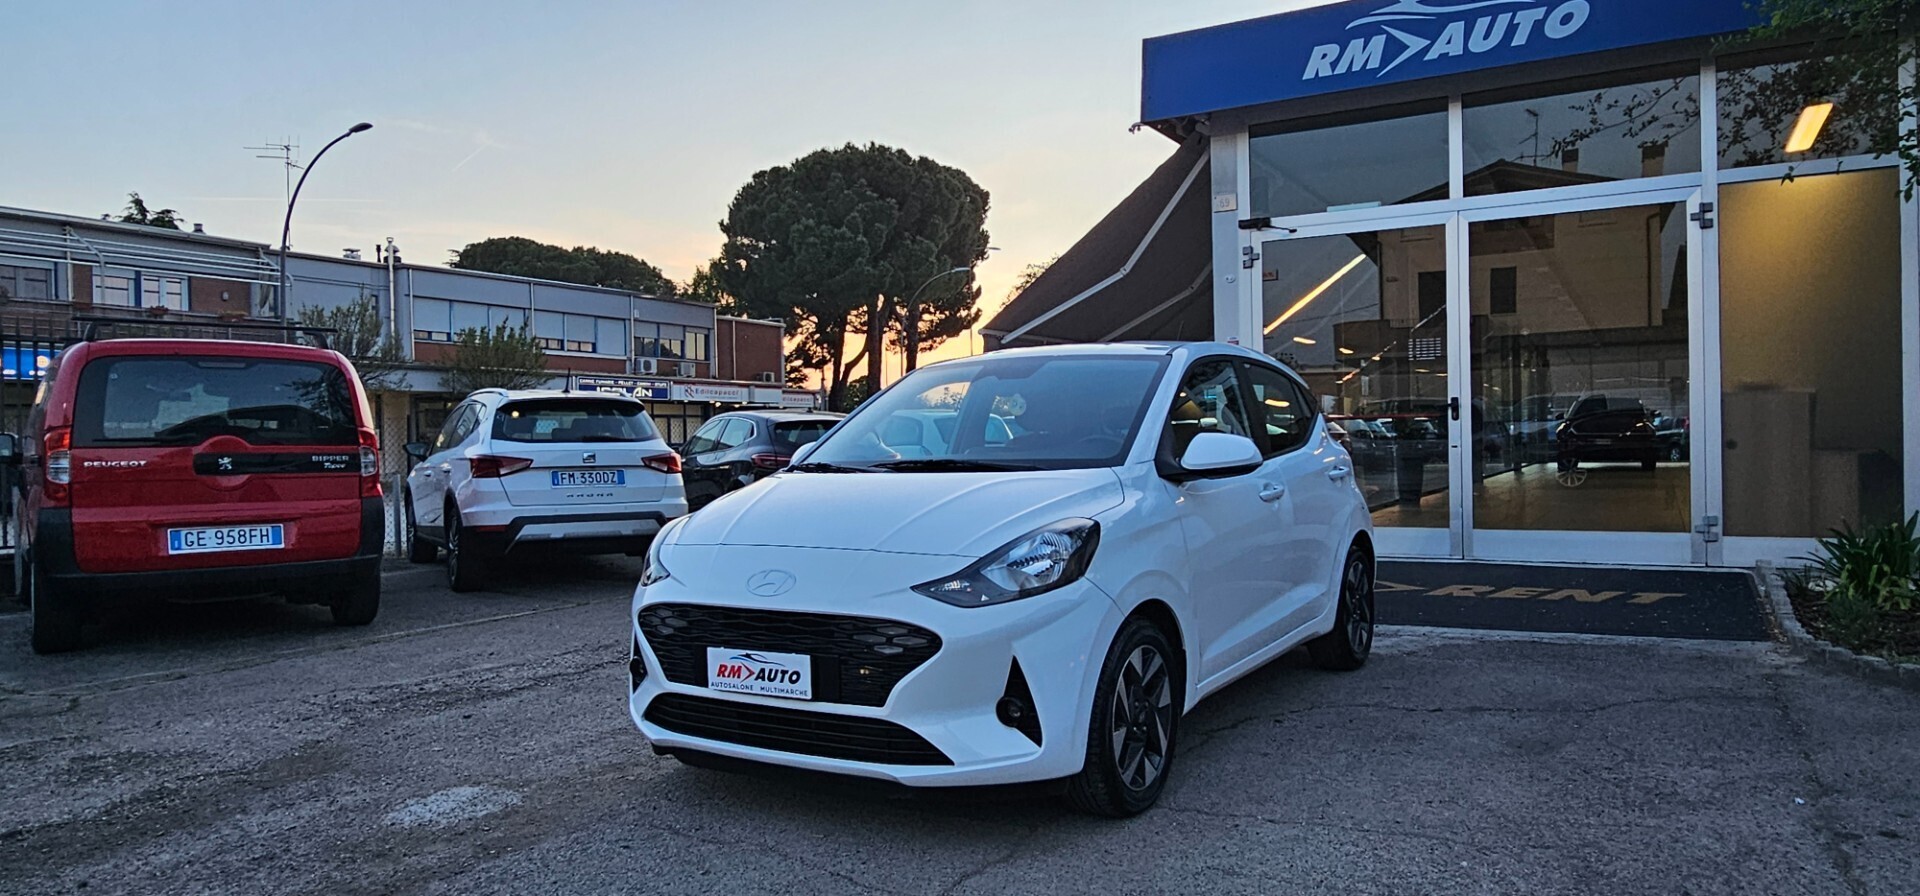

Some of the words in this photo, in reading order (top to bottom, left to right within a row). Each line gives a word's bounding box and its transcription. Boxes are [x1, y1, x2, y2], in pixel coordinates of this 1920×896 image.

[1302, 34, 1386, 80] RM
[1423, 0, 1590, 61] AUTO
[83, 460, 148, 468] PEUGEOT
[560, 472, 575, 484] FM
[580, 471, 617, 484] 330DZ
[184, 531, 207, 547] GE
[214, 528, 270, 546] 958FH
[1423, 584, 1688, 604] RENT
[716, 664, 742, 679] RM
[754, 667, 802, 685] AUTO
[710, 681, 755, 691] AUTOSALONE
[759, 685, 809, 697] MULTIMARCHE
